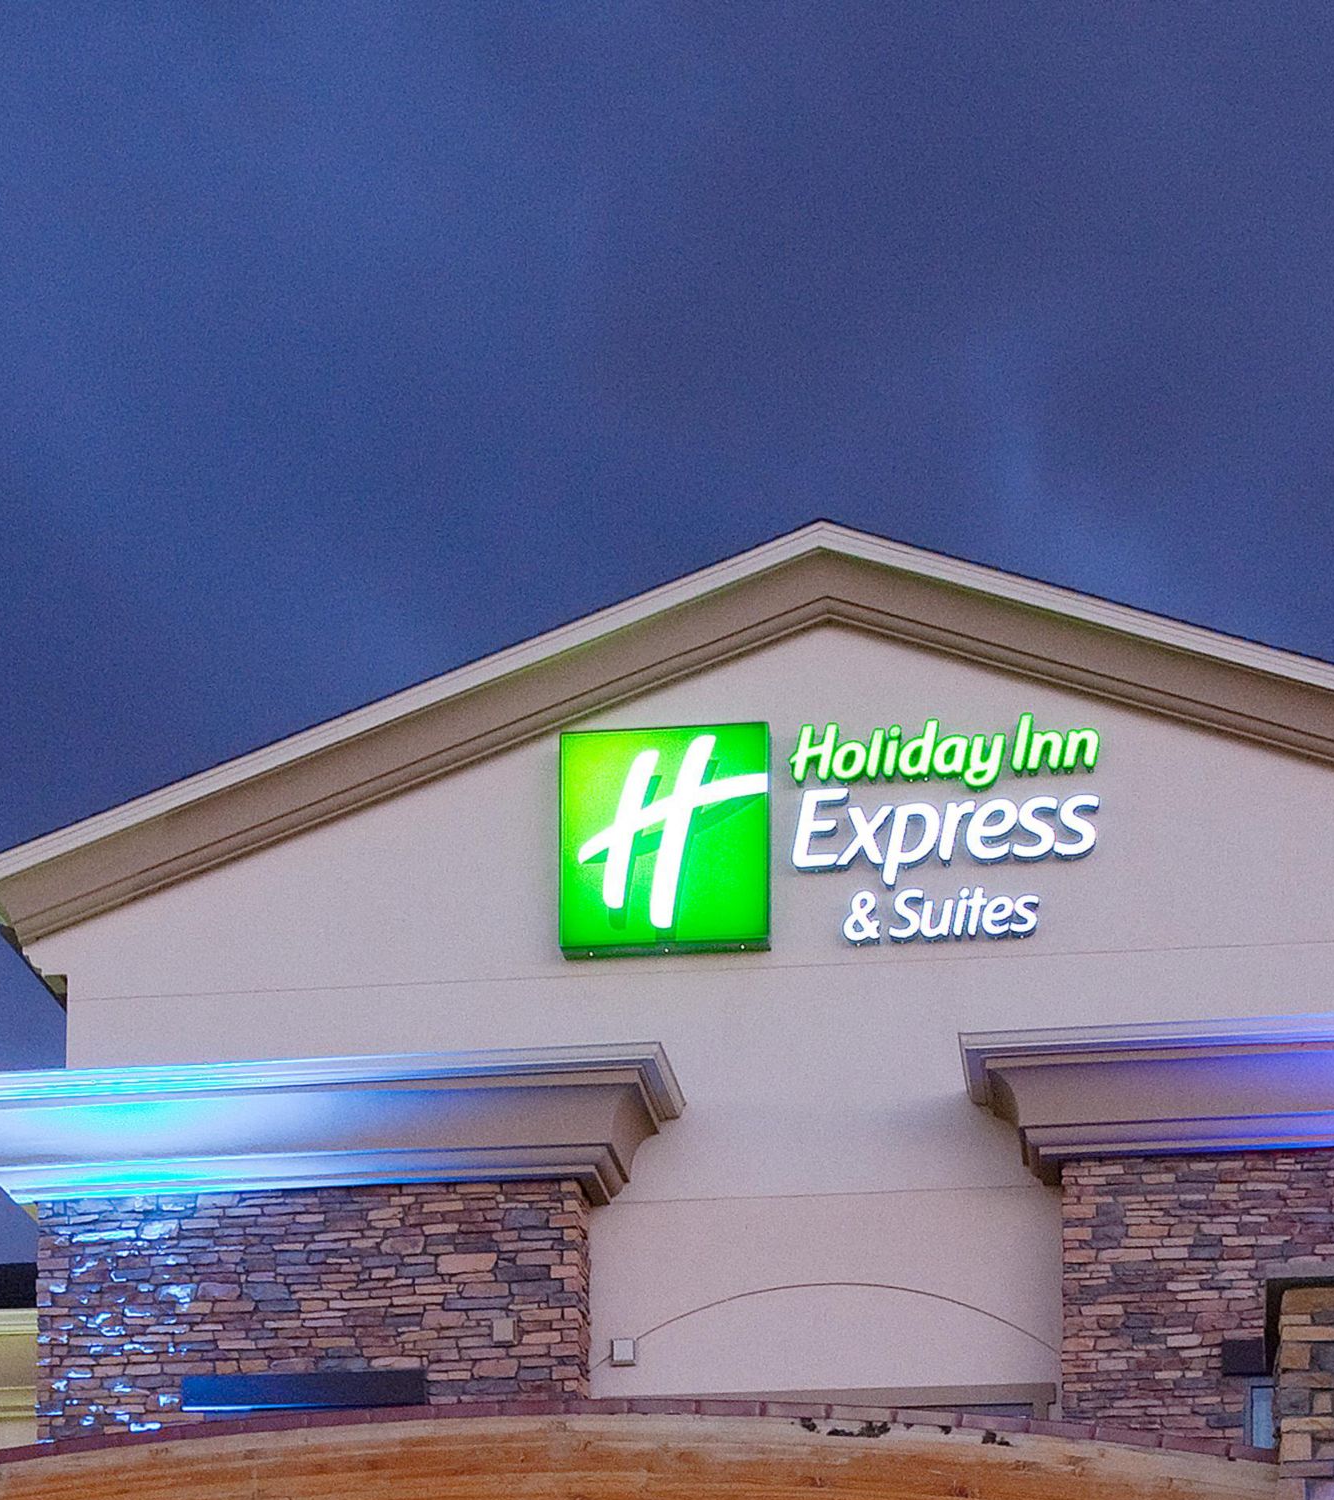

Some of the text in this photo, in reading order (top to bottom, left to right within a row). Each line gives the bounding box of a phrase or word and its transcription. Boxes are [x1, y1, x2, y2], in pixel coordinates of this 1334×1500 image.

[789, 711, 1100, 790] Holiday Inn
[577, 733, 768, 929] H
[791, 787, 1100, 888] Express
[842, 887, 1040, 943] & Suites
